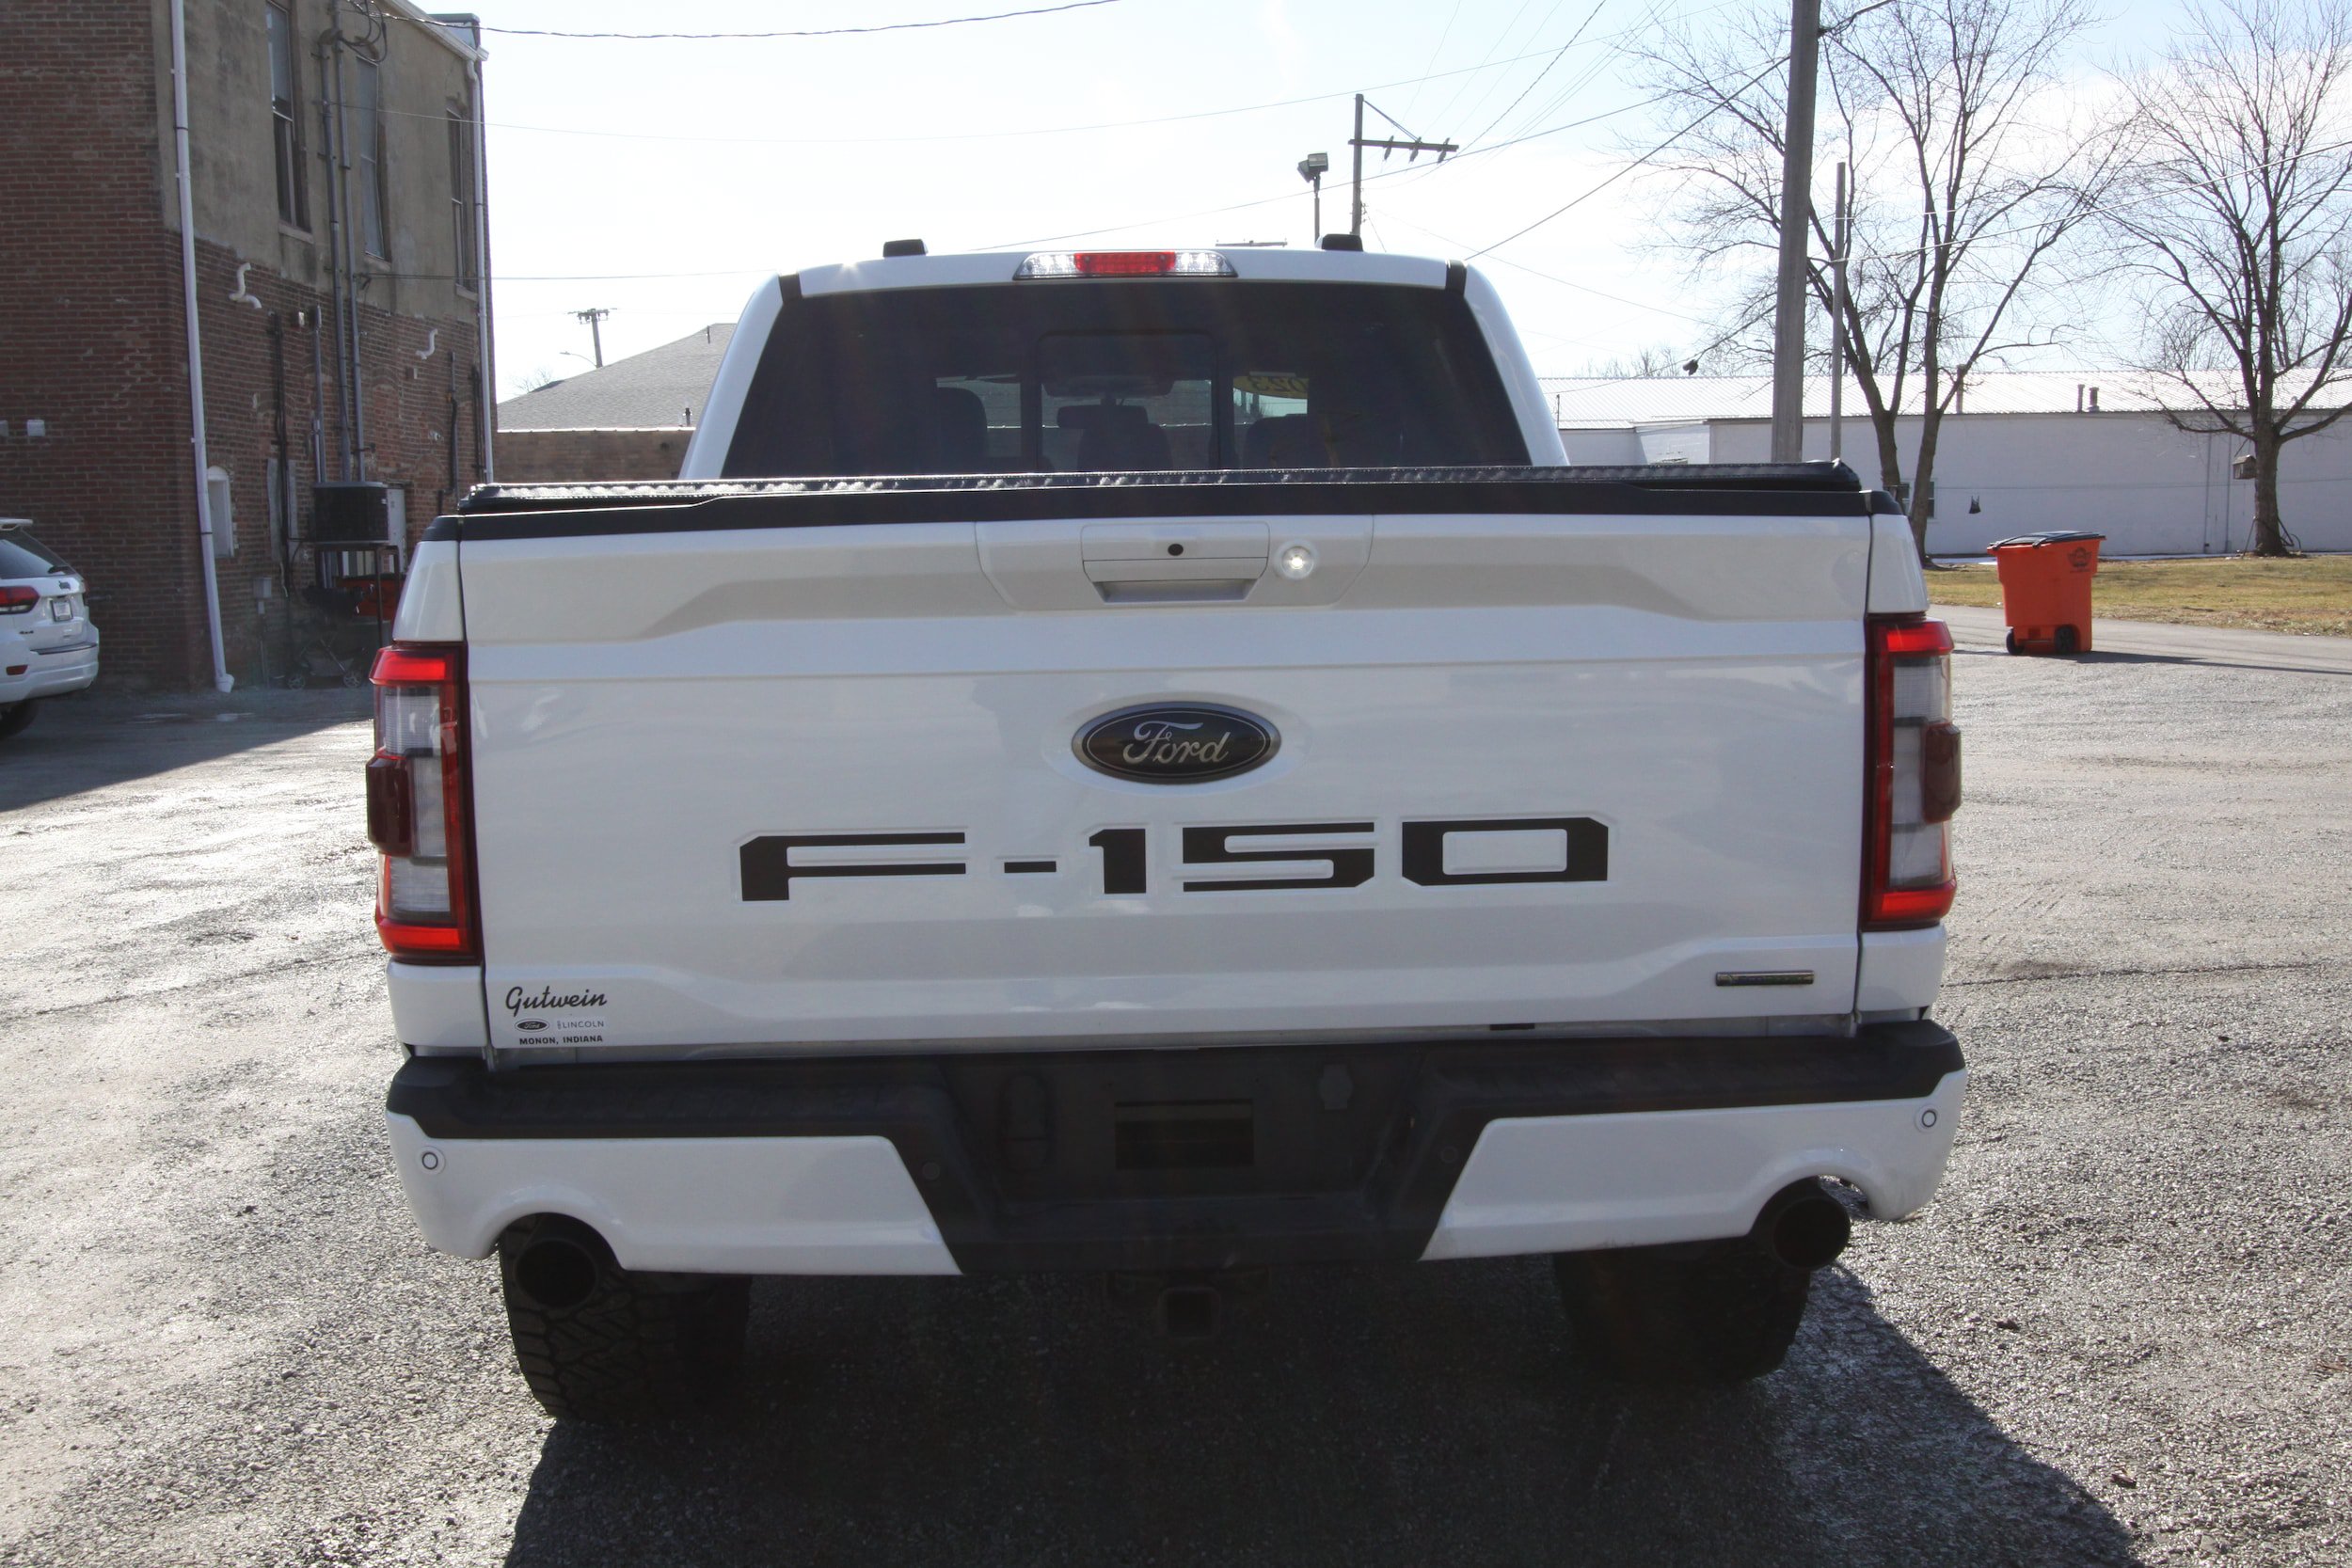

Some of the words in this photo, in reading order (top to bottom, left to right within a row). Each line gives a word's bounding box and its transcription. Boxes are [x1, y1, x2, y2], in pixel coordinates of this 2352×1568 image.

[1122, 720, 1232, 765] Ford
[739, 816, 1609, 902] F-150
[505, 985, 608, 1017] Gutwein
[519, 1037, 560, 1046] MONON,
[563, 1034, 603, 1044] INDIANA
[562, 1020, 605, 1029] LINCOLN
